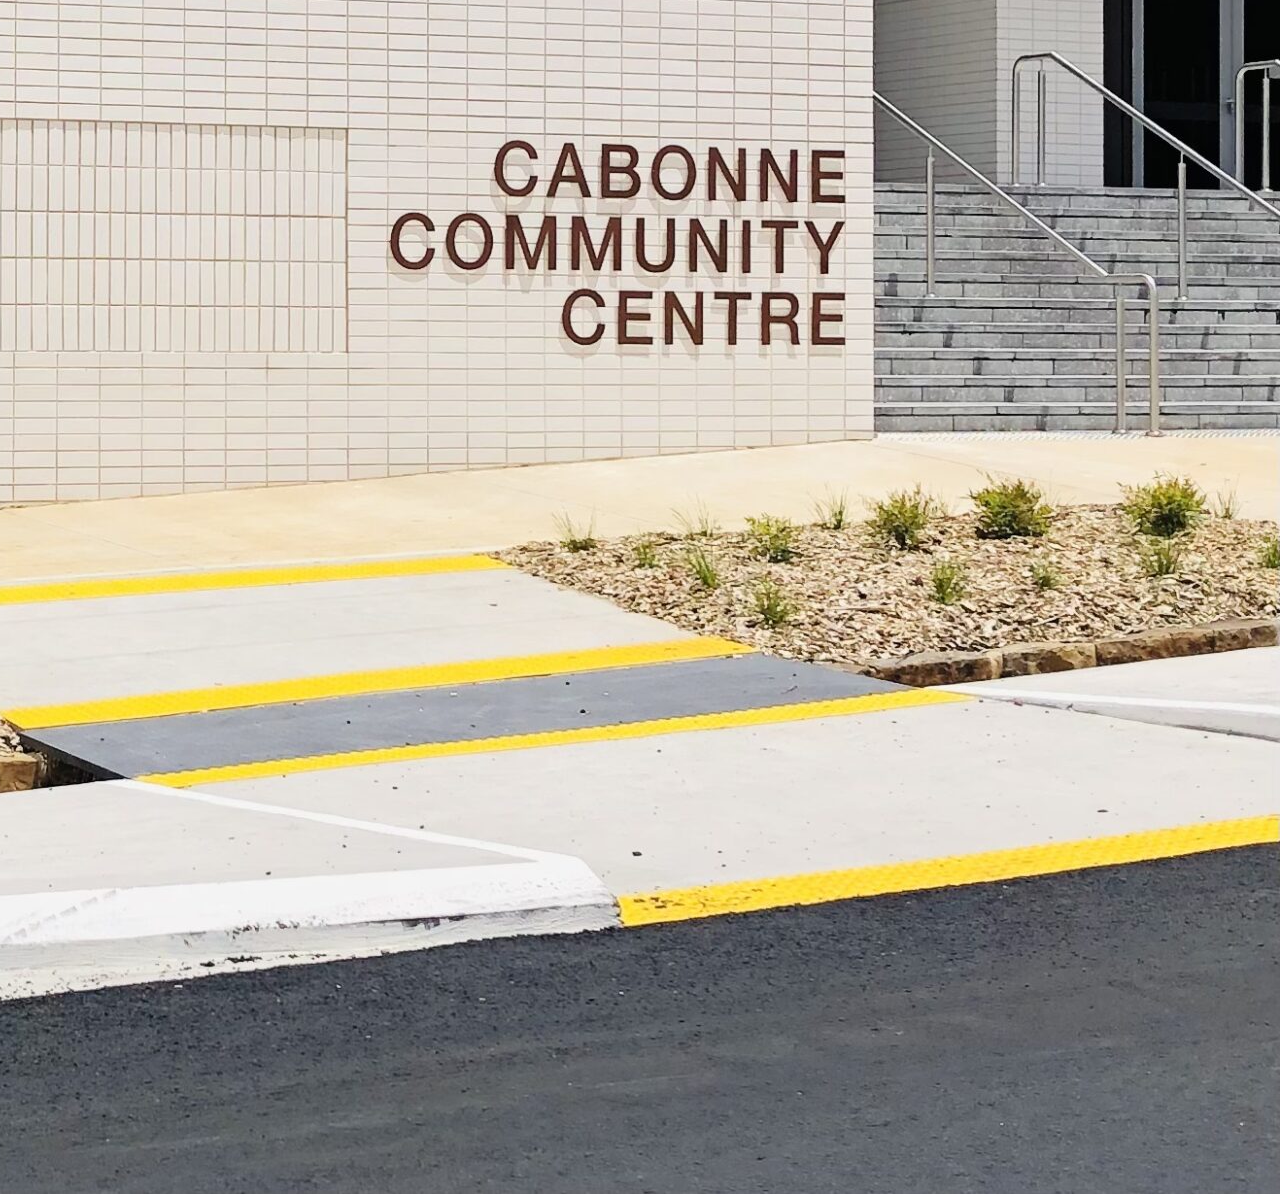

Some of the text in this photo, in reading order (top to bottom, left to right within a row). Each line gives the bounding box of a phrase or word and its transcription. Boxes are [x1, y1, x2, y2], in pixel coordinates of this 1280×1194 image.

[494, 140, 846, 203] CABONNE
[390, 212, 846, 274] COMMUNITY
[562, 288, 846, 346] CENTRE
